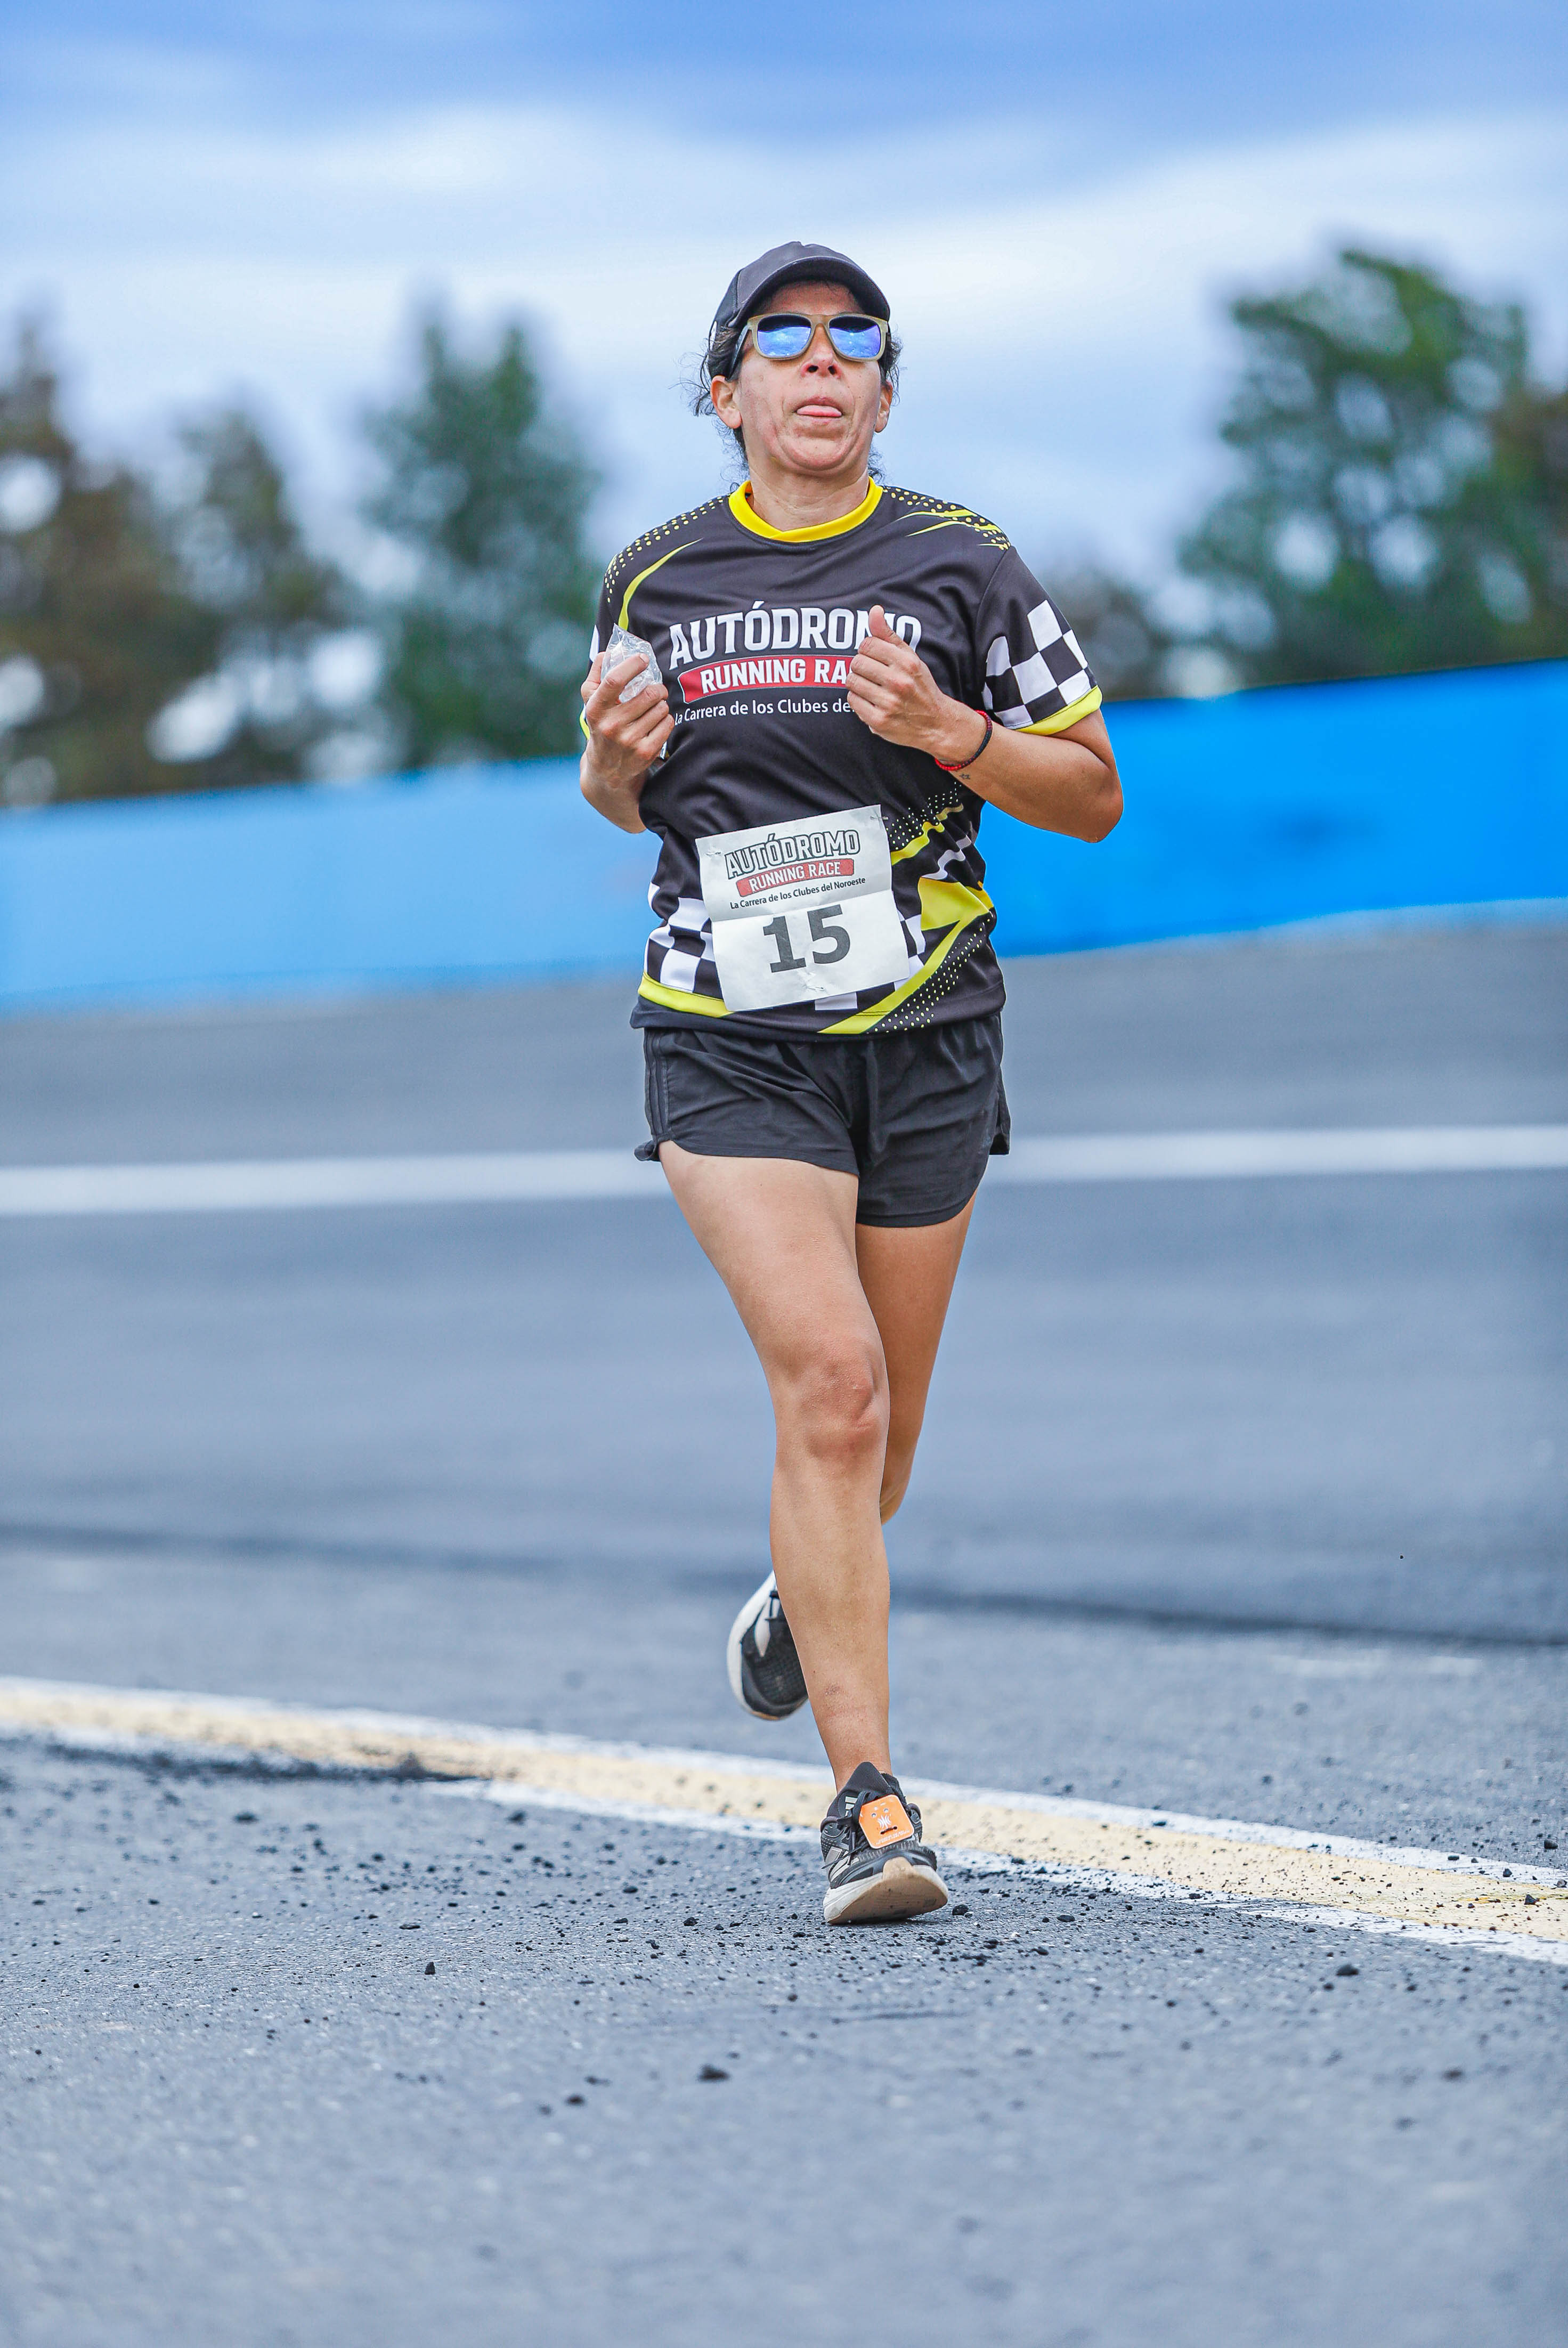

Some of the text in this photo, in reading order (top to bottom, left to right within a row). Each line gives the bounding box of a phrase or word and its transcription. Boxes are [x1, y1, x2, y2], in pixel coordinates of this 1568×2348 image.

[701, 659, 852, 694] RUNNING RA
[685, 705, 726, 722] Carrera
[730, 701, 748, 715] de
[752, 700, 774, 714] los
[777, 698, 828, 713] Clubes
[832, 698, 855, 713] de
[725, 830, 860, 879] AUTÓDROMO
[740, 897, 767, 907] Carrera
[793, 887, 819, 898] Clubes
[821, 883, 833, 892] del
[834, 878, 866, 890] Noroeste
[749, 861, 841, 892] RUNNING RACE
[763, 904, 850, 973] 15
